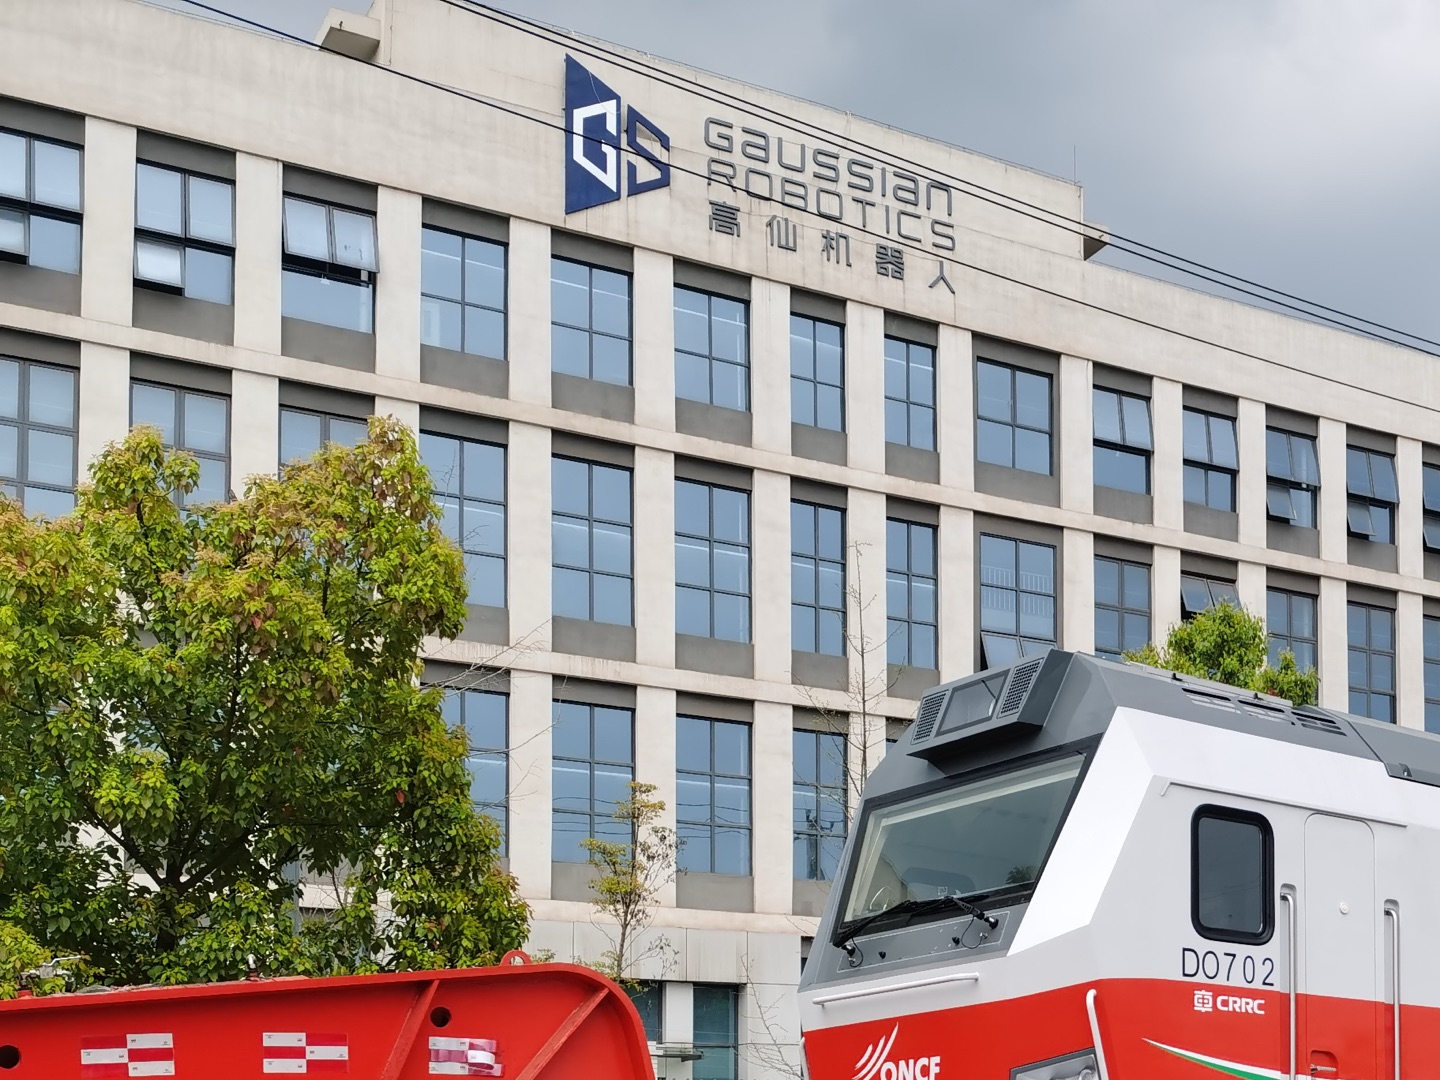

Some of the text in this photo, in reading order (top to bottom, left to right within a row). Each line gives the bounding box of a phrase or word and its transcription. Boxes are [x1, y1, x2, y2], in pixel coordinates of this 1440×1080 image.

[706, 157, 956, 252] ROBOTICS
[708, 200, 956, 295] 高仙机器人
[1216, 995, 1265, 1015] CRRC
